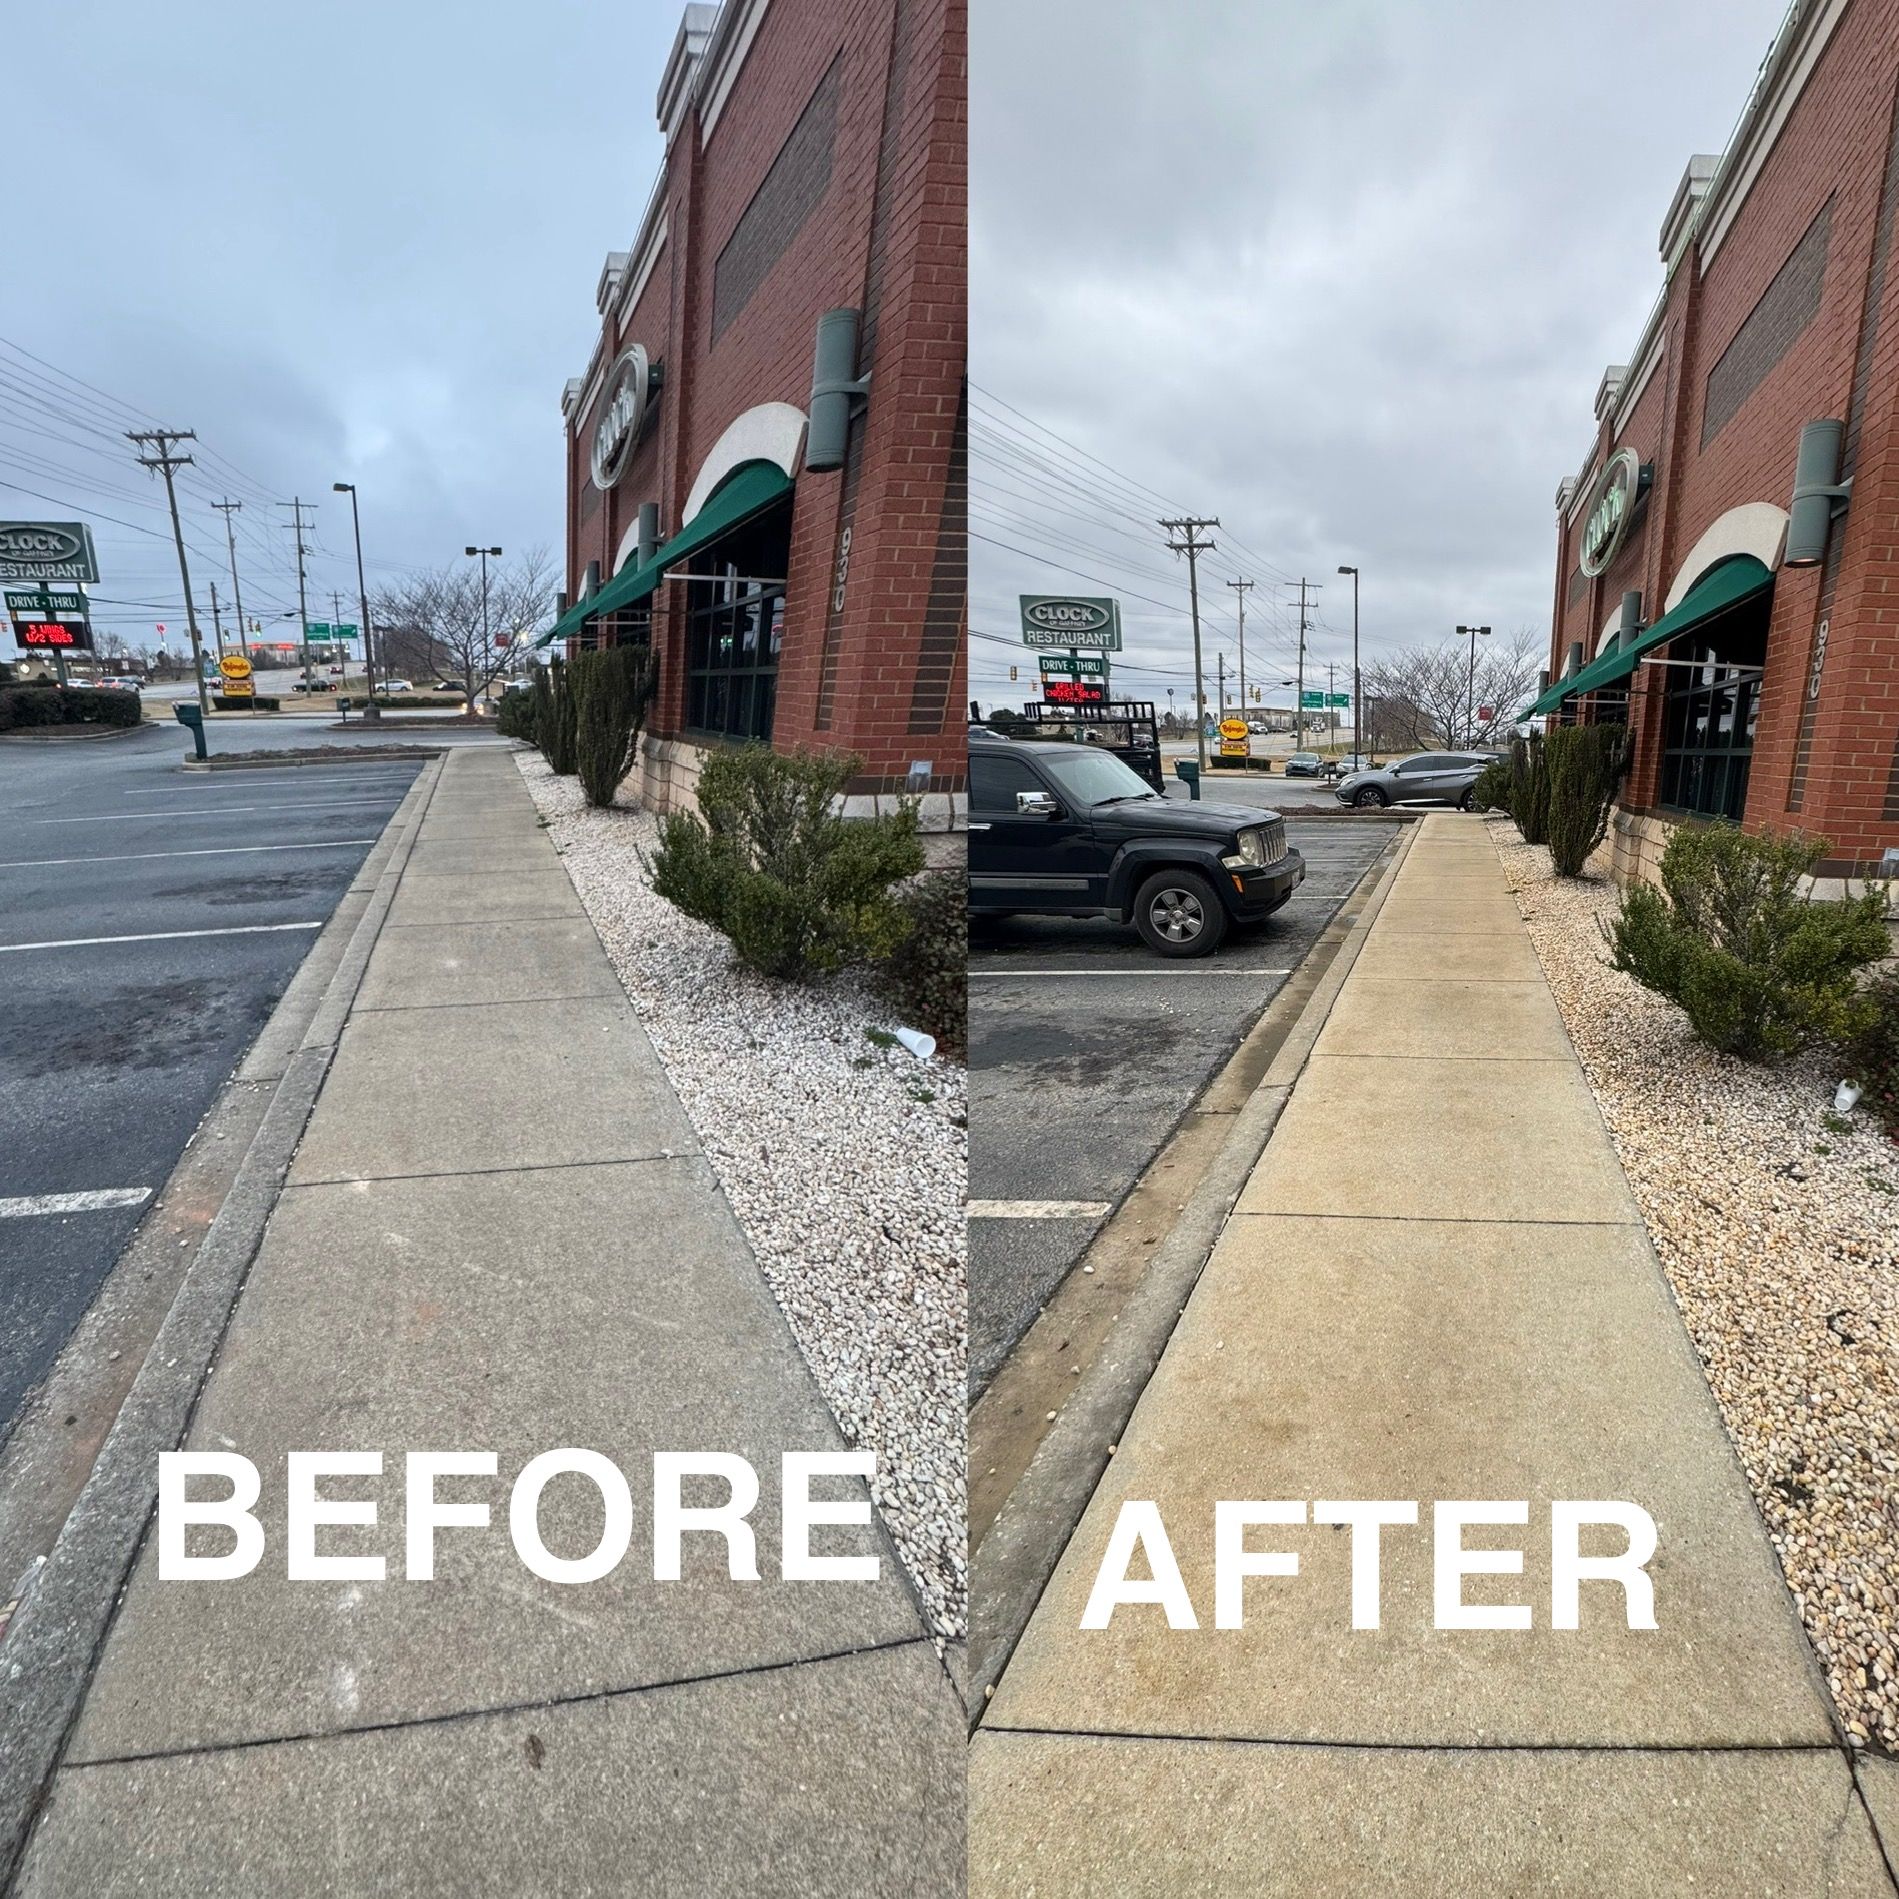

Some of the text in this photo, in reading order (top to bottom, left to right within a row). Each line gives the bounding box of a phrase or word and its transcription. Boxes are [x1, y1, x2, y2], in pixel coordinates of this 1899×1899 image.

[0, 563, 85, 578] ESTAURANT
[8, 596, 40, 608] DRIVE
[49, 596, 77, 609] THRU
[1035, 606, 1095, 622] CLOCK
[1027, 630, 1112, 646] RESTAURANT
[1041, 659, 1068, 671] DRIVE
[1075, 661, 1101, 673] THRU
